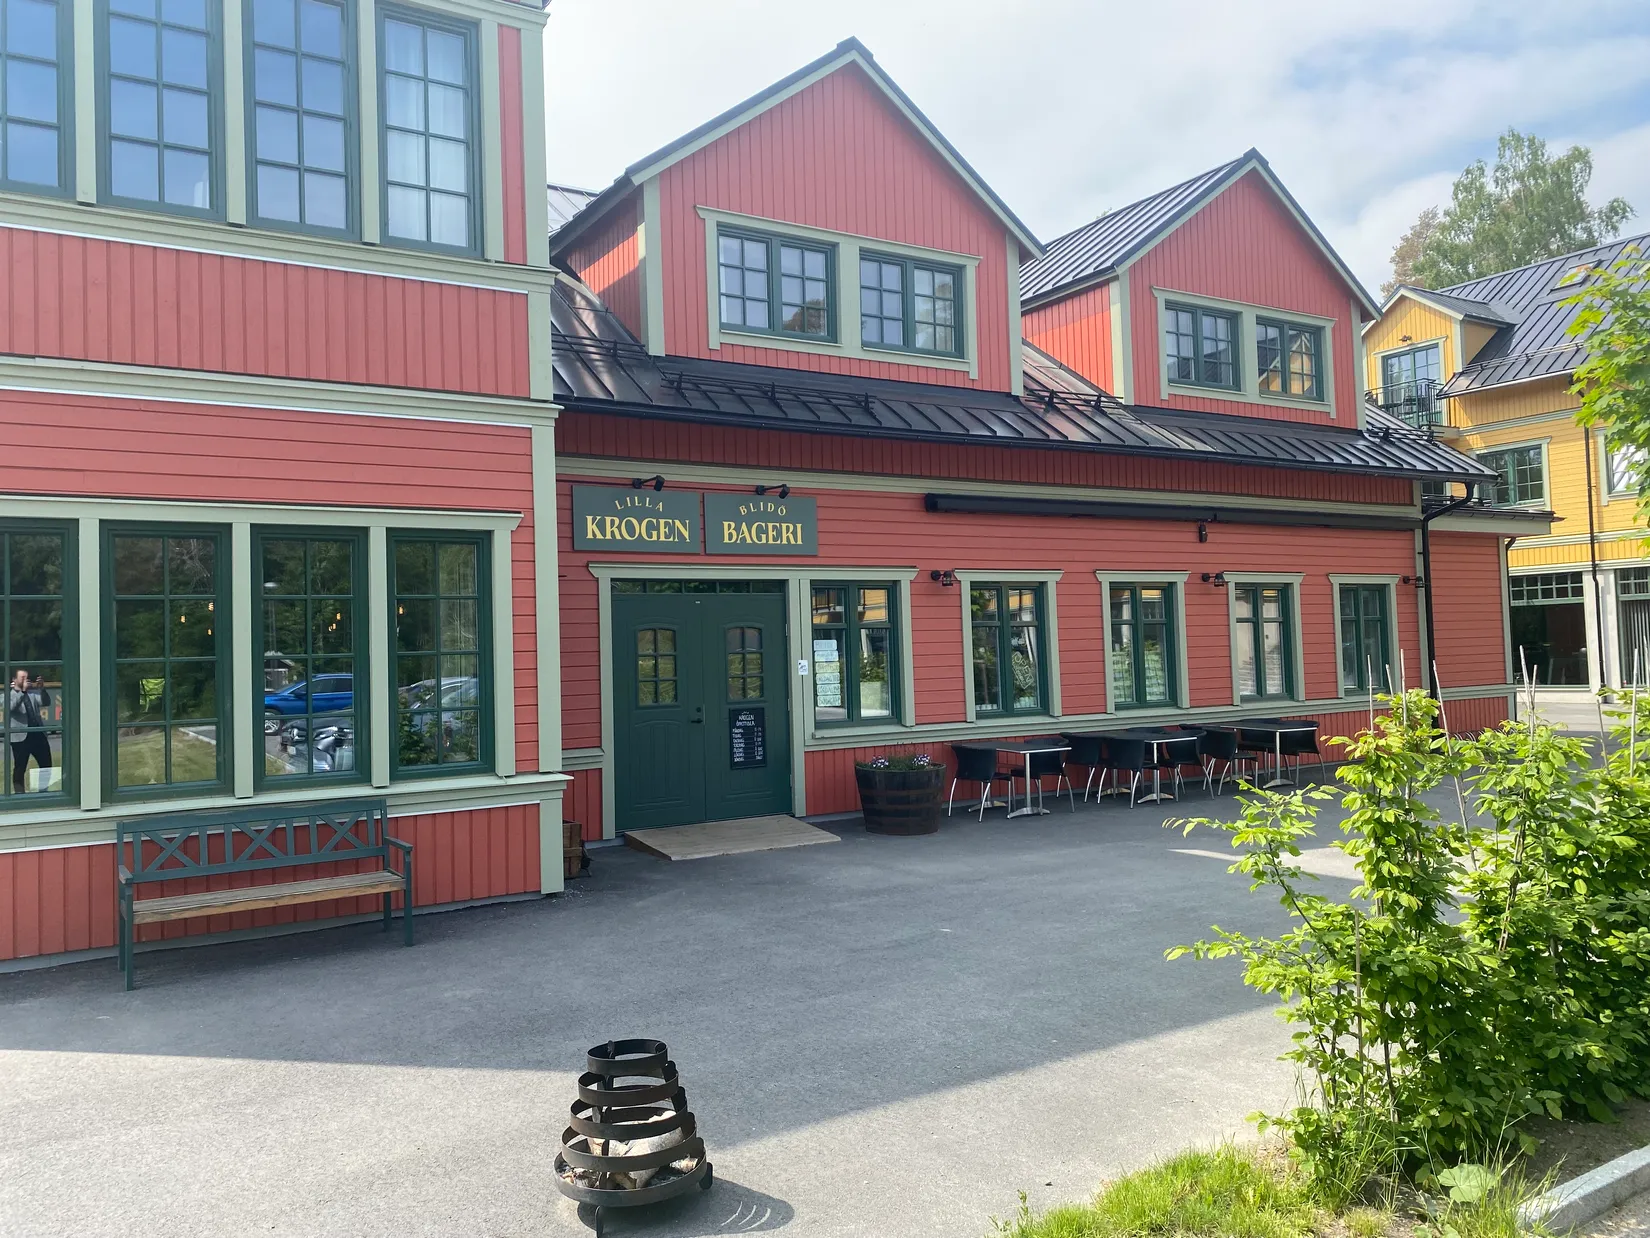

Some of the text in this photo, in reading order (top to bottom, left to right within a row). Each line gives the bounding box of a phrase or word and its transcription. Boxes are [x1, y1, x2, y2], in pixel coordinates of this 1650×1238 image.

[614, 495, 664, 512] LILLA
[585, 515, 691, 542] KROGEN
[722, 520, 804, 545] BAGERI
